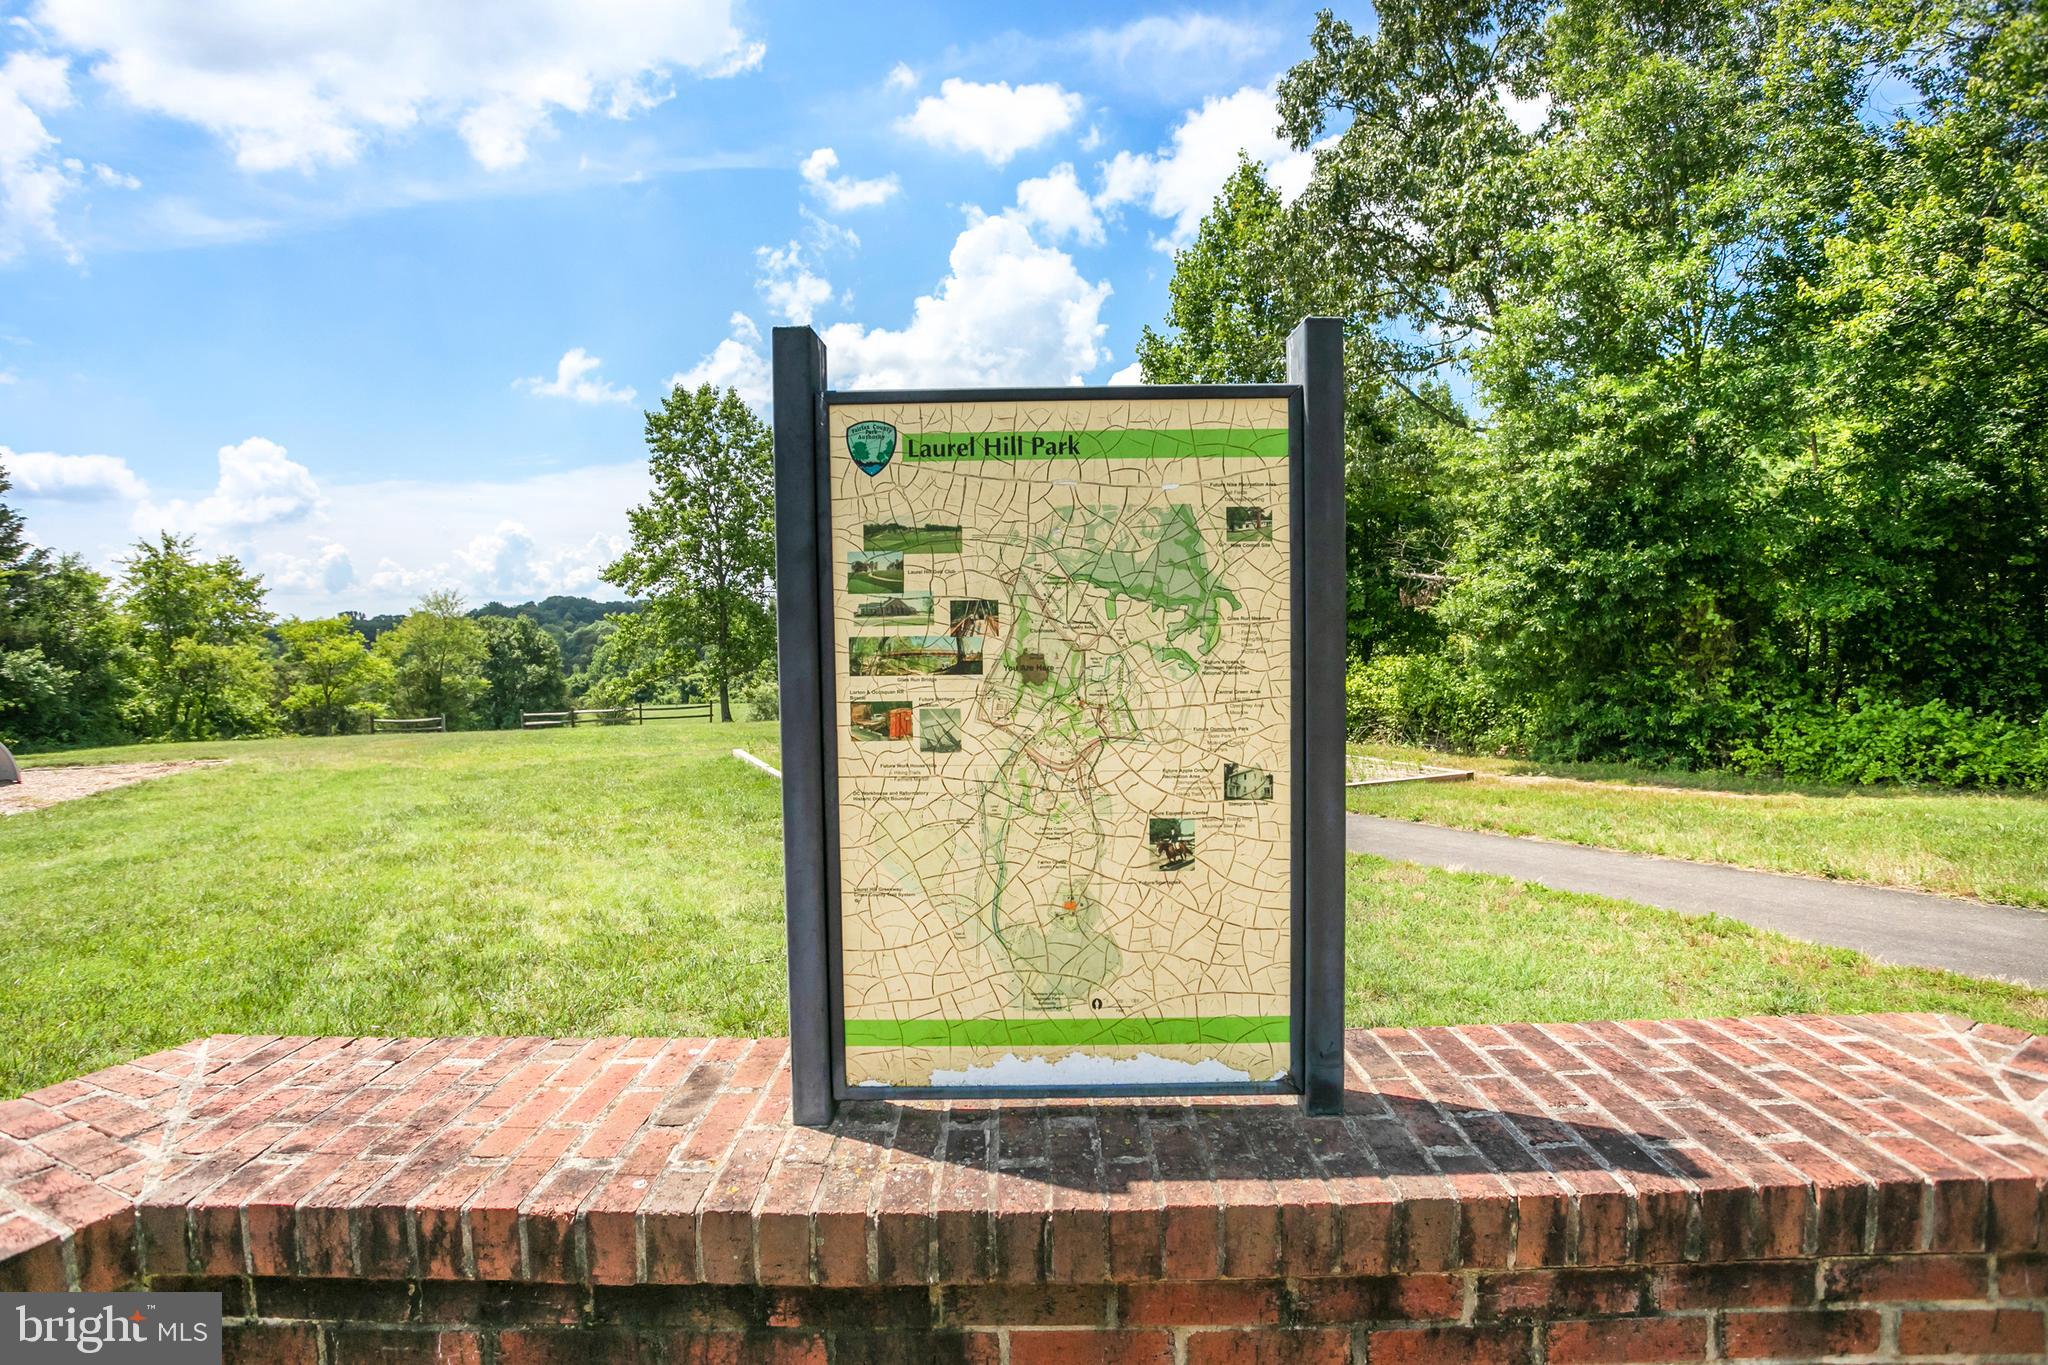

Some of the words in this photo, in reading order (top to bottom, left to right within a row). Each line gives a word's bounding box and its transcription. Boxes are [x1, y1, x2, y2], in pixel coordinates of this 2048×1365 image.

[851, 425, 870, 434] Fairfax
[872, 424, 893, 434] County
[908, 436, 975, 458] Laurel
[984, 435, 1022, 456] Hill
[1031, 434, 1081, 455] Park
